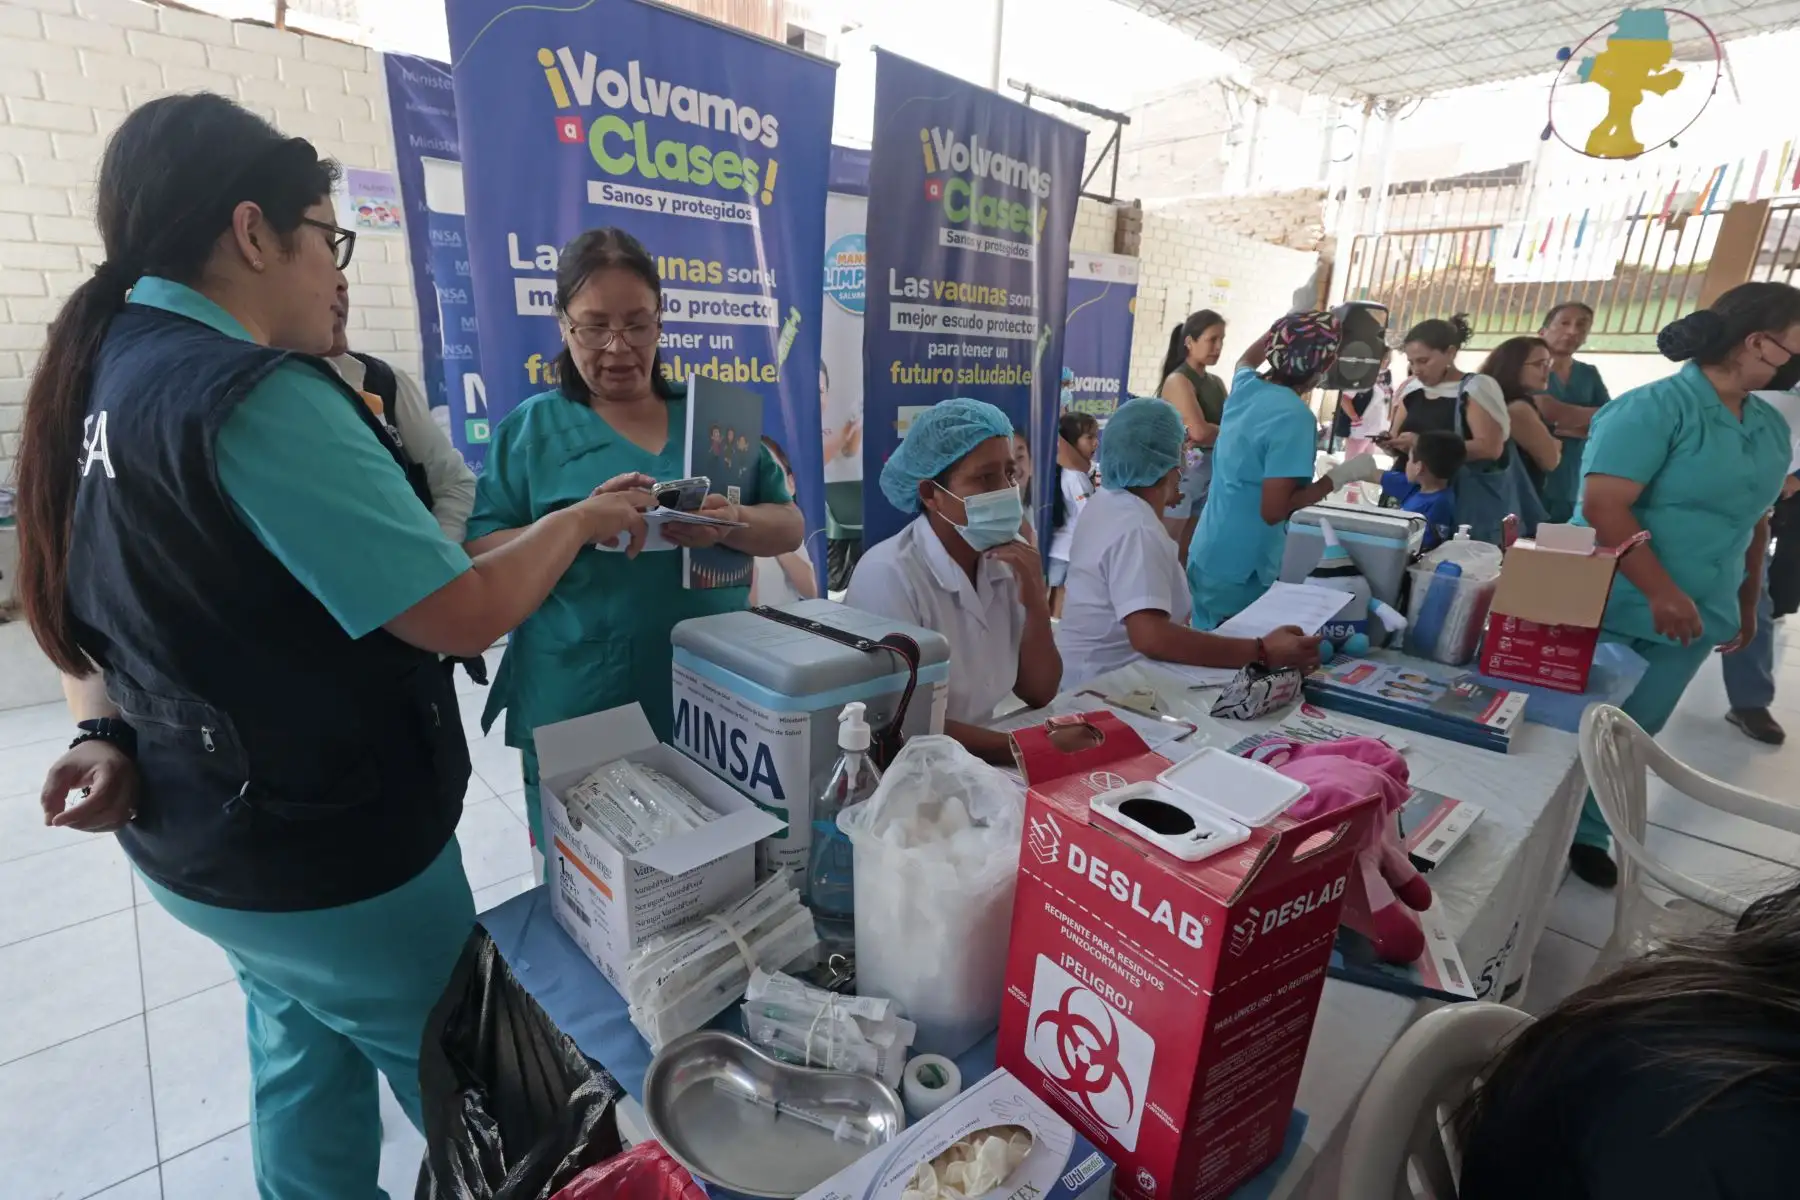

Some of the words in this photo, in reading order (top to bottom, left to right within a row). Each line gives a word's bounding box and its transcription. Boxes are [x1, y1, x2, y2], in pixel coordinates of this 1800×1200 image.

[402, 68, 455, 90] Ministe
[537, 46, 779, 148] ¡Volvamos
[409, 134, 461, 153] Ministe
[564, 122, 577, 139] a
[588, 114, 778, 206] Clases!
[920, 127, 1051, 199] ¡Volvamos
[602, 184, 653, 206] Sanos
[658, 195, 668, 212] y
[671, 199, 752, 221] protegidos
[930, 183, 939, 196] a
[943, 177, 1048, 242] Clases!
[947, 230, 975, 246] Sanos
[976, 239, 982, 249] y
[984, 240, 1029, 258] protegidos
[889, 267, 930, 299] Las
[933, 280, 1008, 307] vacunas
[1010, 292, 1031, 308] son
[688, 297, 772, 319] protecto
[897, 308, 938, 330] mejor
[942, 312, 983, 331] escudo
[986, 318, 1035, 334] protecto
[659, 332, 703, 349] ener
[709, 333, 733, 350] un
[928, 341, 960, 360] para
[961, 341, 994, 359] tener
[995, 345, 1008, 359] un
[660, 355, 780, 384] aludable.
[890, 360, 953, 385] futuro
[673, 698, 786, 800] MINSA
[1261, 875, 1347, 935] DESLAB
[1044, 902, 1091, 940] RECIPIENTE
[1091, 934, 1115, 957] PARA
[1117, 952, 1165, 991] RESIDUOS
[1060, 926, 1141, 988] PUNZOCORTANTES
[1060, 952, 1134, 1015] ¡PELIGRO!
